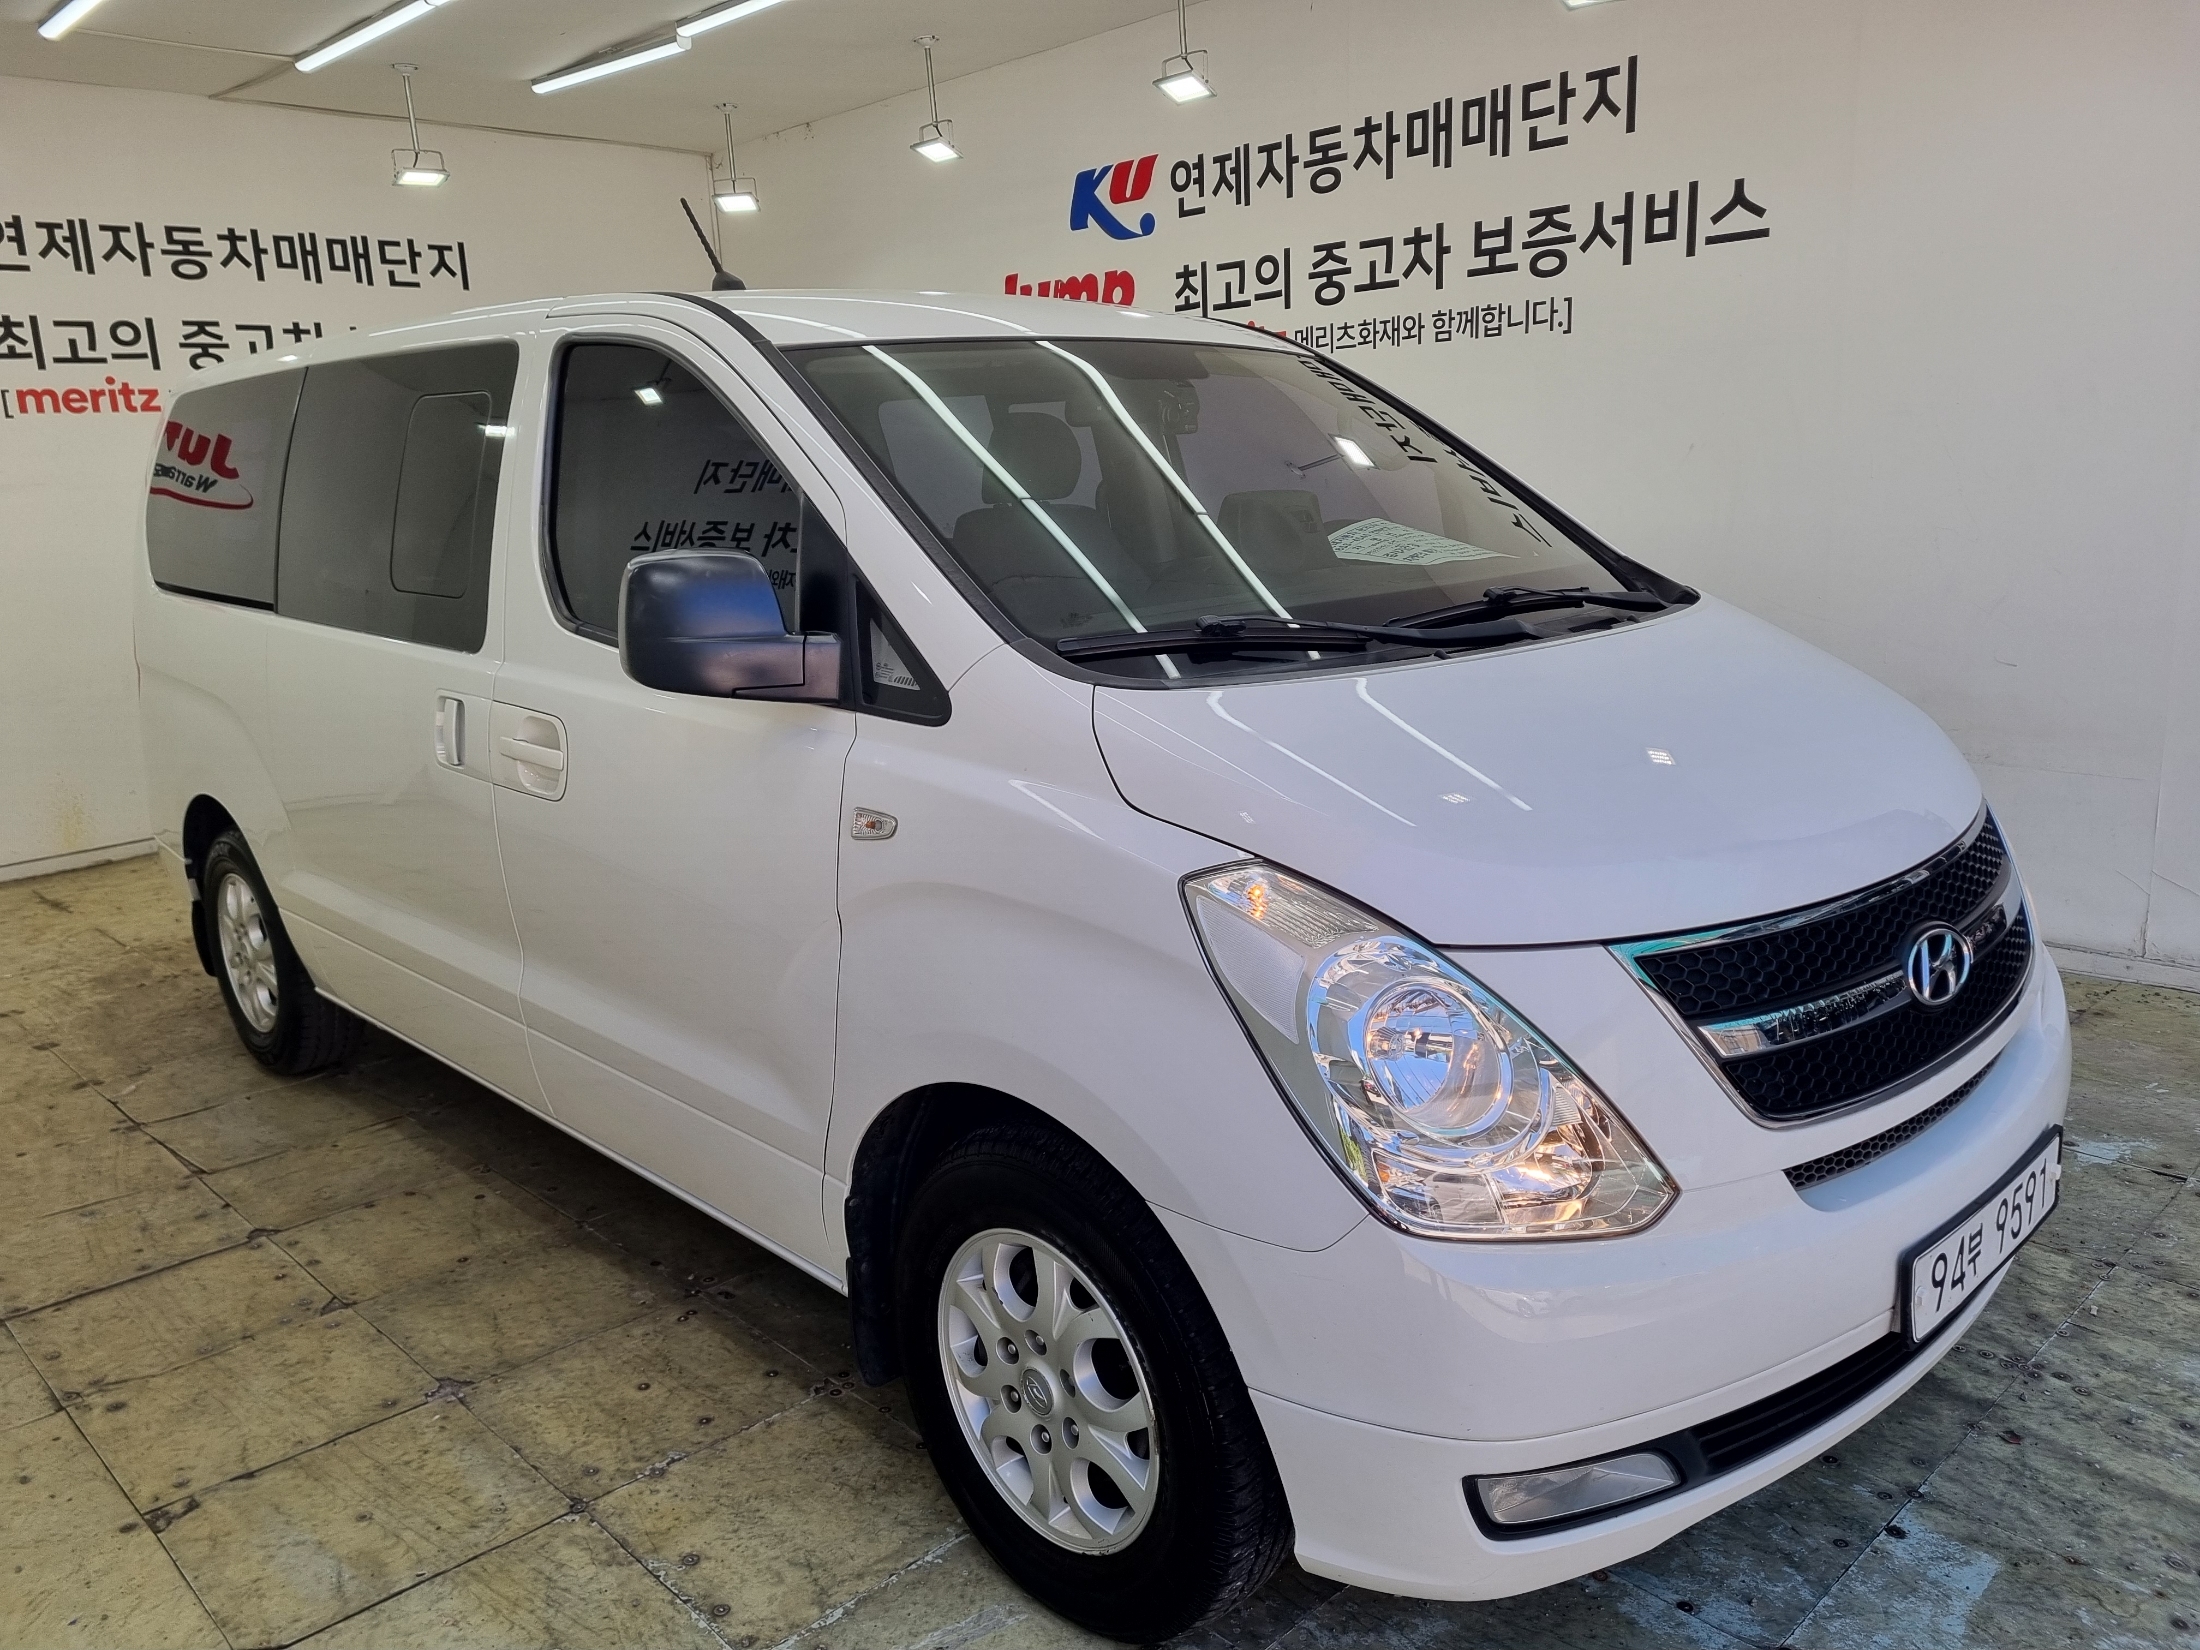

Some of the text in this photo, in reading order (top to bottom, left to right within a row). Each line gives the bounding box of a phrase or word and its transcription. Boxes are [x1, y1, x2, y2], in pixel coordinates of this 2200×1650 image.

[1170, 55, 1638, 219] 연제자동차매매단지
[0, 215, 471, 291] 연제자동차매매단지
[1174, 178, 1770, 319] 최고의 중고차 보증서비스
[0, 314, 161, 371] 최고의
[1294, 312, 1426, 354] 메리츠화재와
[1931, 1157, 2047, 1313] 94부 9591
